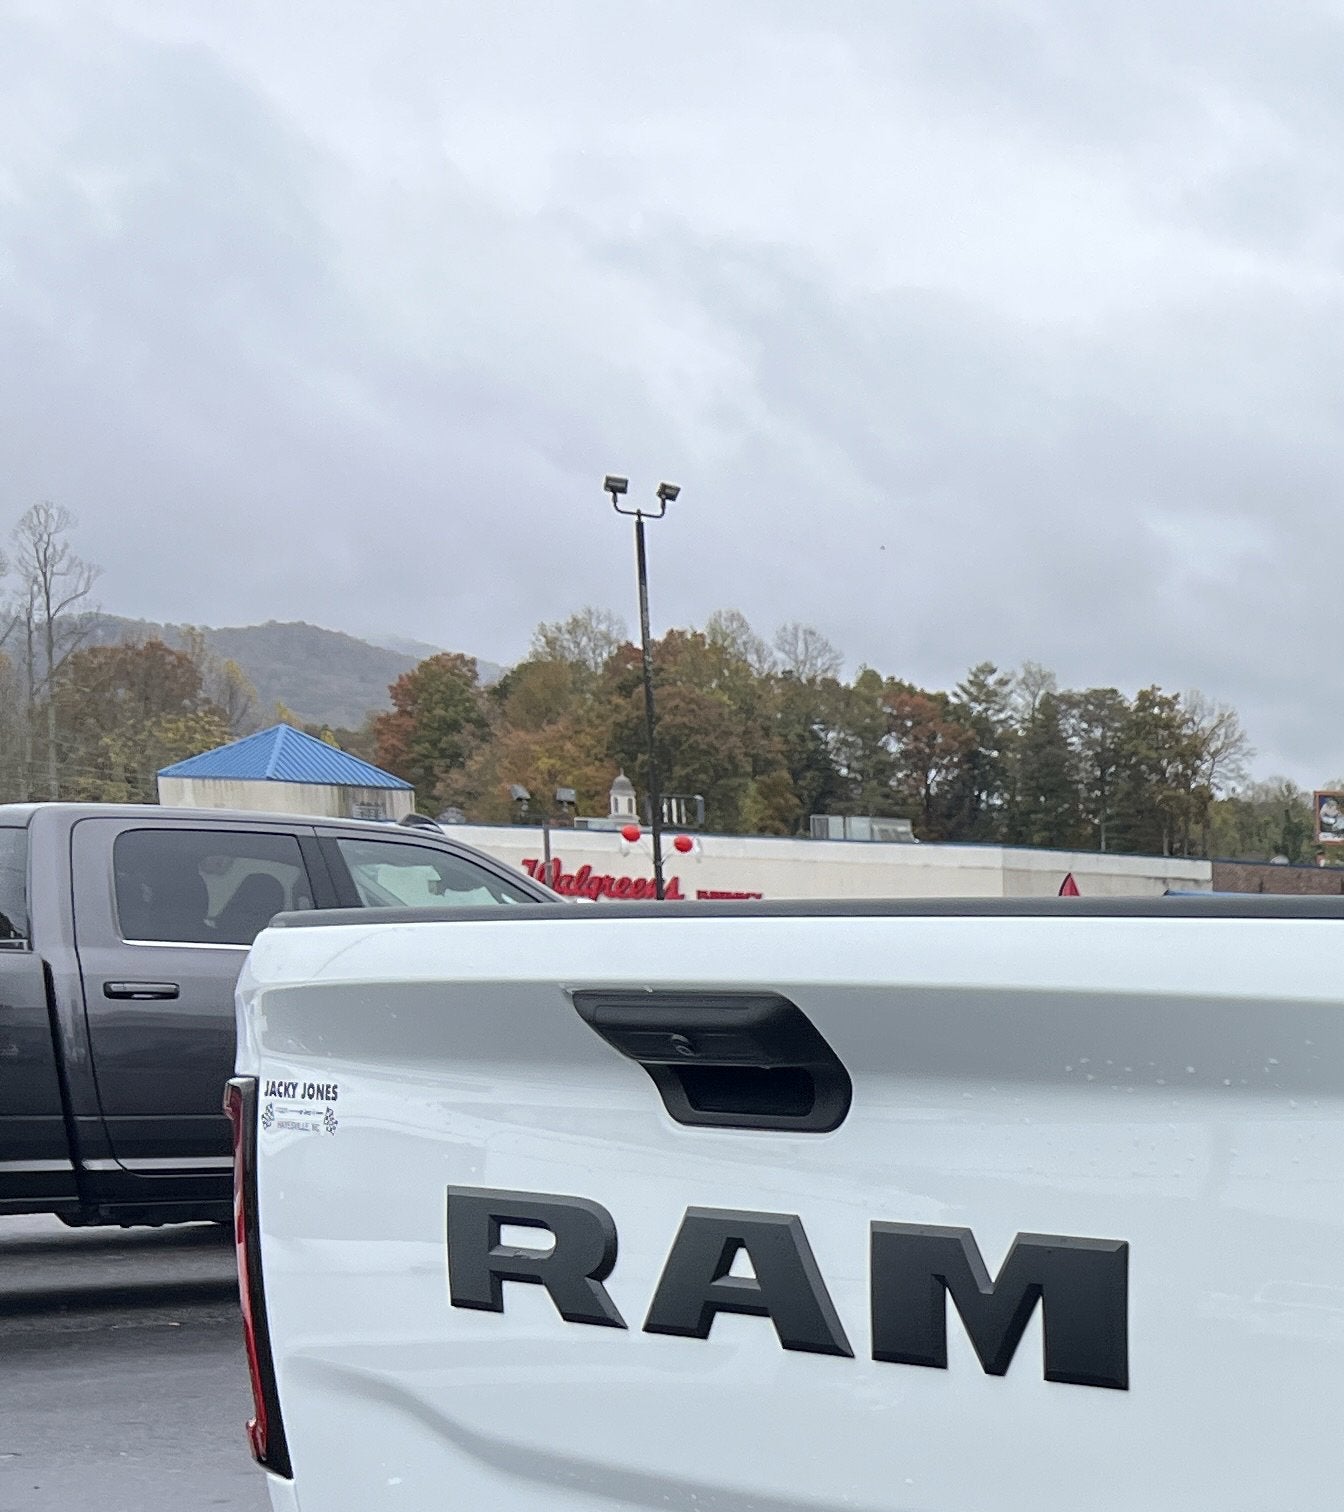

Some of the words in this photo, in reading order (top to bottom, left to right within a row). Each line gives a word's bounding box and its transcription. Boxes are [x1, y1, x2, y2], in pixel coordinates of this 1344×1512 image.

[522, 857, 685, 900] Walgreens
[264, 1080, 298, 1099] JACKY
[301, 1082, 338, 1102] JONES
[447, 1185, 1130, 1391] RAM
